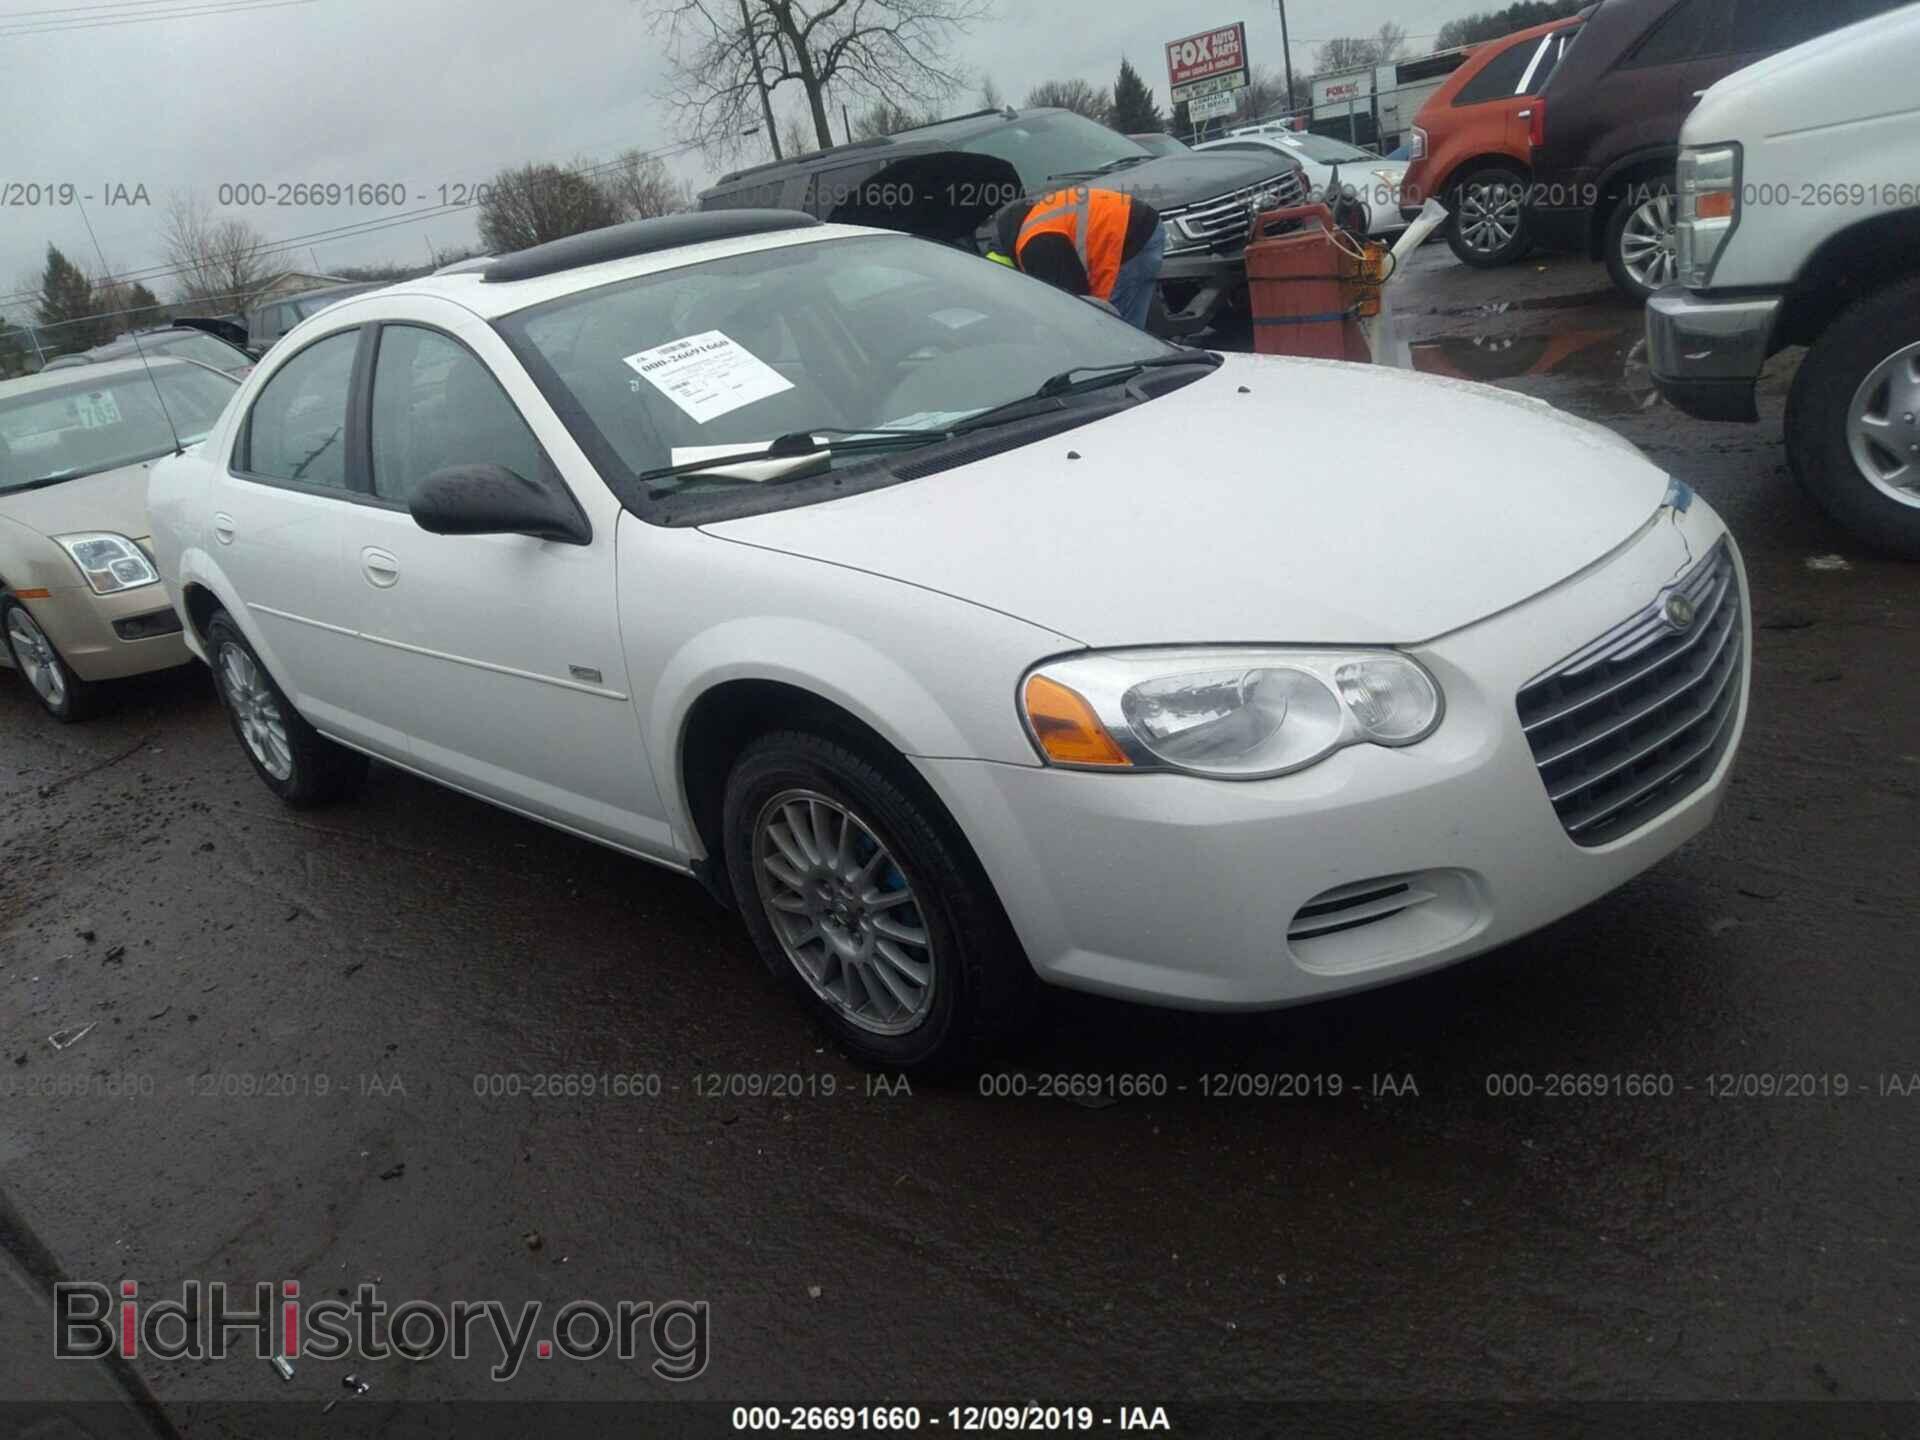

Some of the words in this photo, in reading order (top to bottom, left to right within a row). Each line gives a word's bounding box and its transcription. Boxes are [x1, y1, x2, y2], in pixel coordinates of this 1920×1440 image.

[1212, 29, 1235, 46] AUTO
[1170, 36, 1212, 70] FOX
[1213, 41, 1239, 58] PARTS
